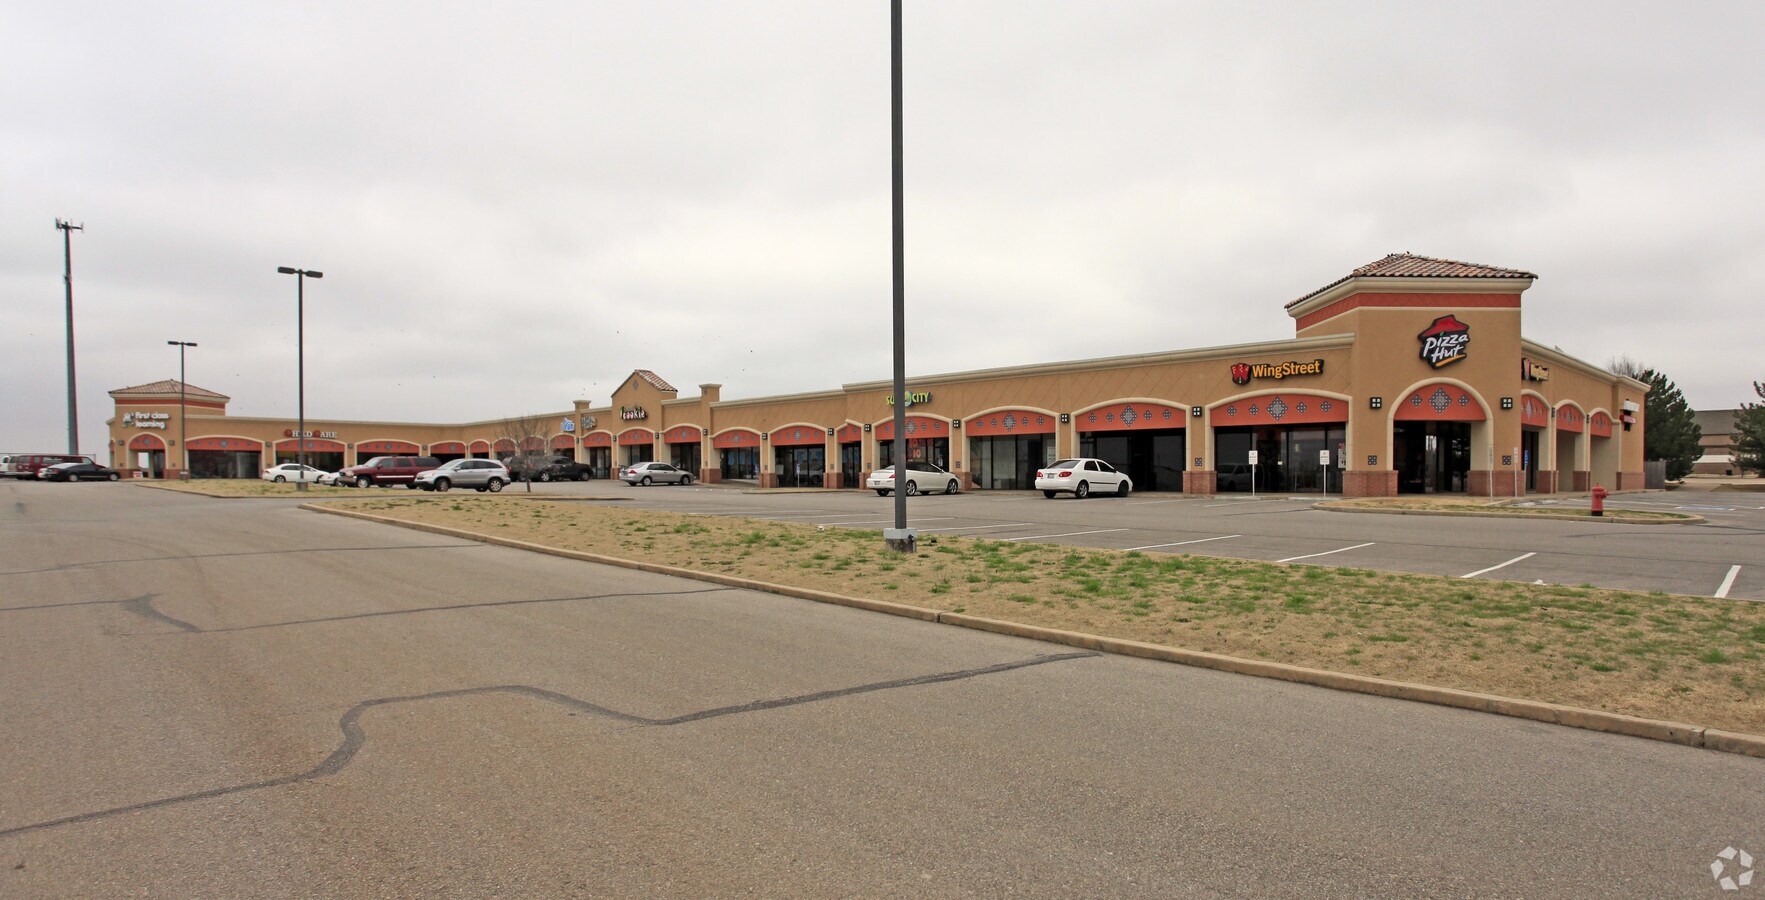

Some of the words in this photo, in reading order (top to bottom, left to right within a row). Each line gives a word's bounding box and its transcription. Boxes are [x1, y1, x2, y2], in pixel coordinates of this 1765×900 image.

[1423, 332, 1469, 357] Pizza
[1431, 345, 1464, 363] Hut
[1252, 360, 1320, 379] WingStreet
[912, 392, 929, 403] CITY
[135, 411, 150, 419] first
[151, 411, 169, 419] class
[135, 420, 166, 429] learning
